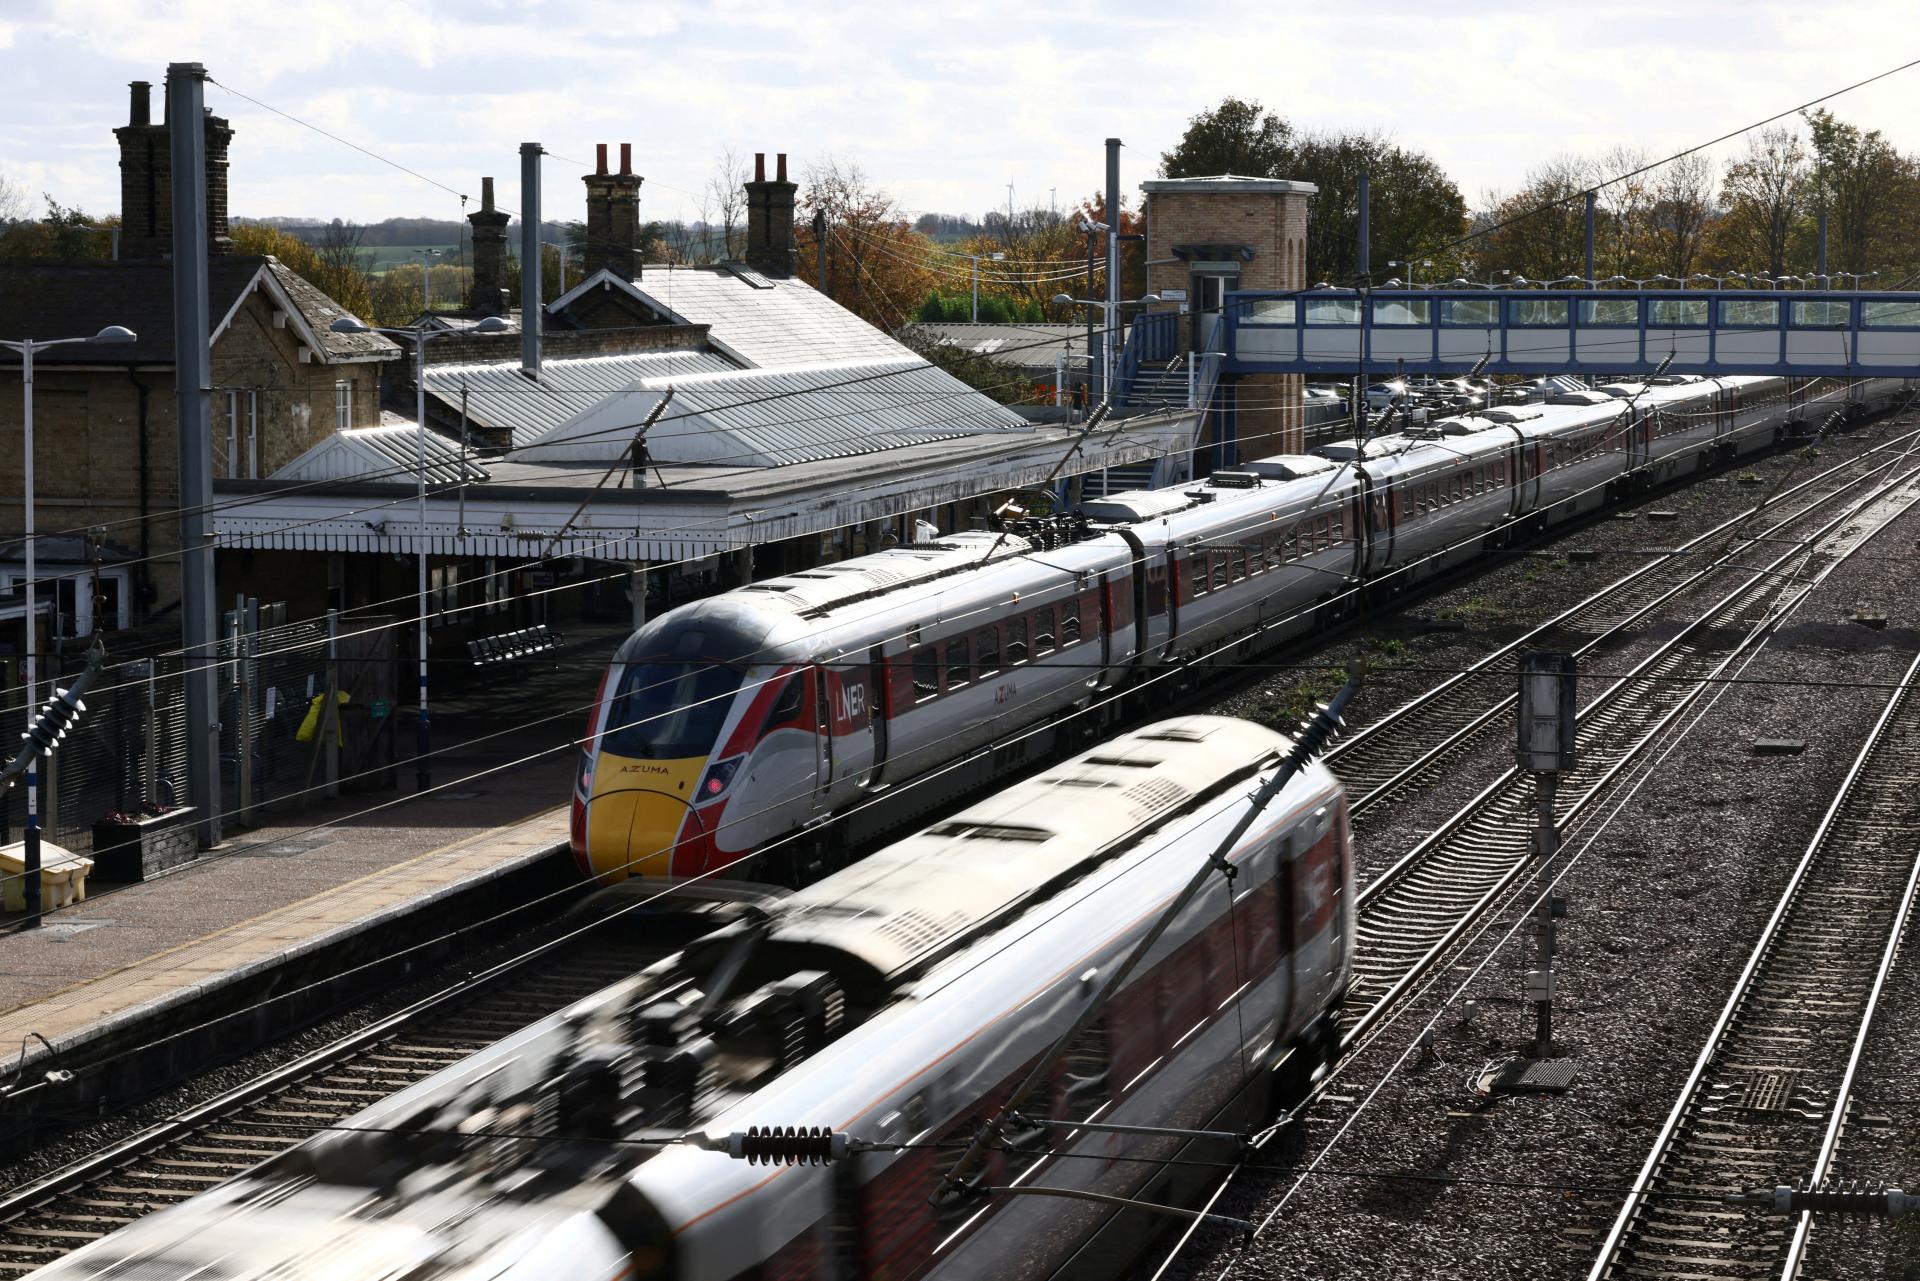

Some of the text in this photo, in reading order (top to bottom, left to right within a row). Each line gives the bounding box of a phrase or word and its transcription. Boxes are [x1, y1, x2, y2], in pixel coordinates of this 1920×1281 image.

[1361, 401, 1368, 413] 2
[995, 681, 1016, 704] AZUMA
[835, 681, 865, 724] LNER
[620, 765, 669, 775] AZUMA
